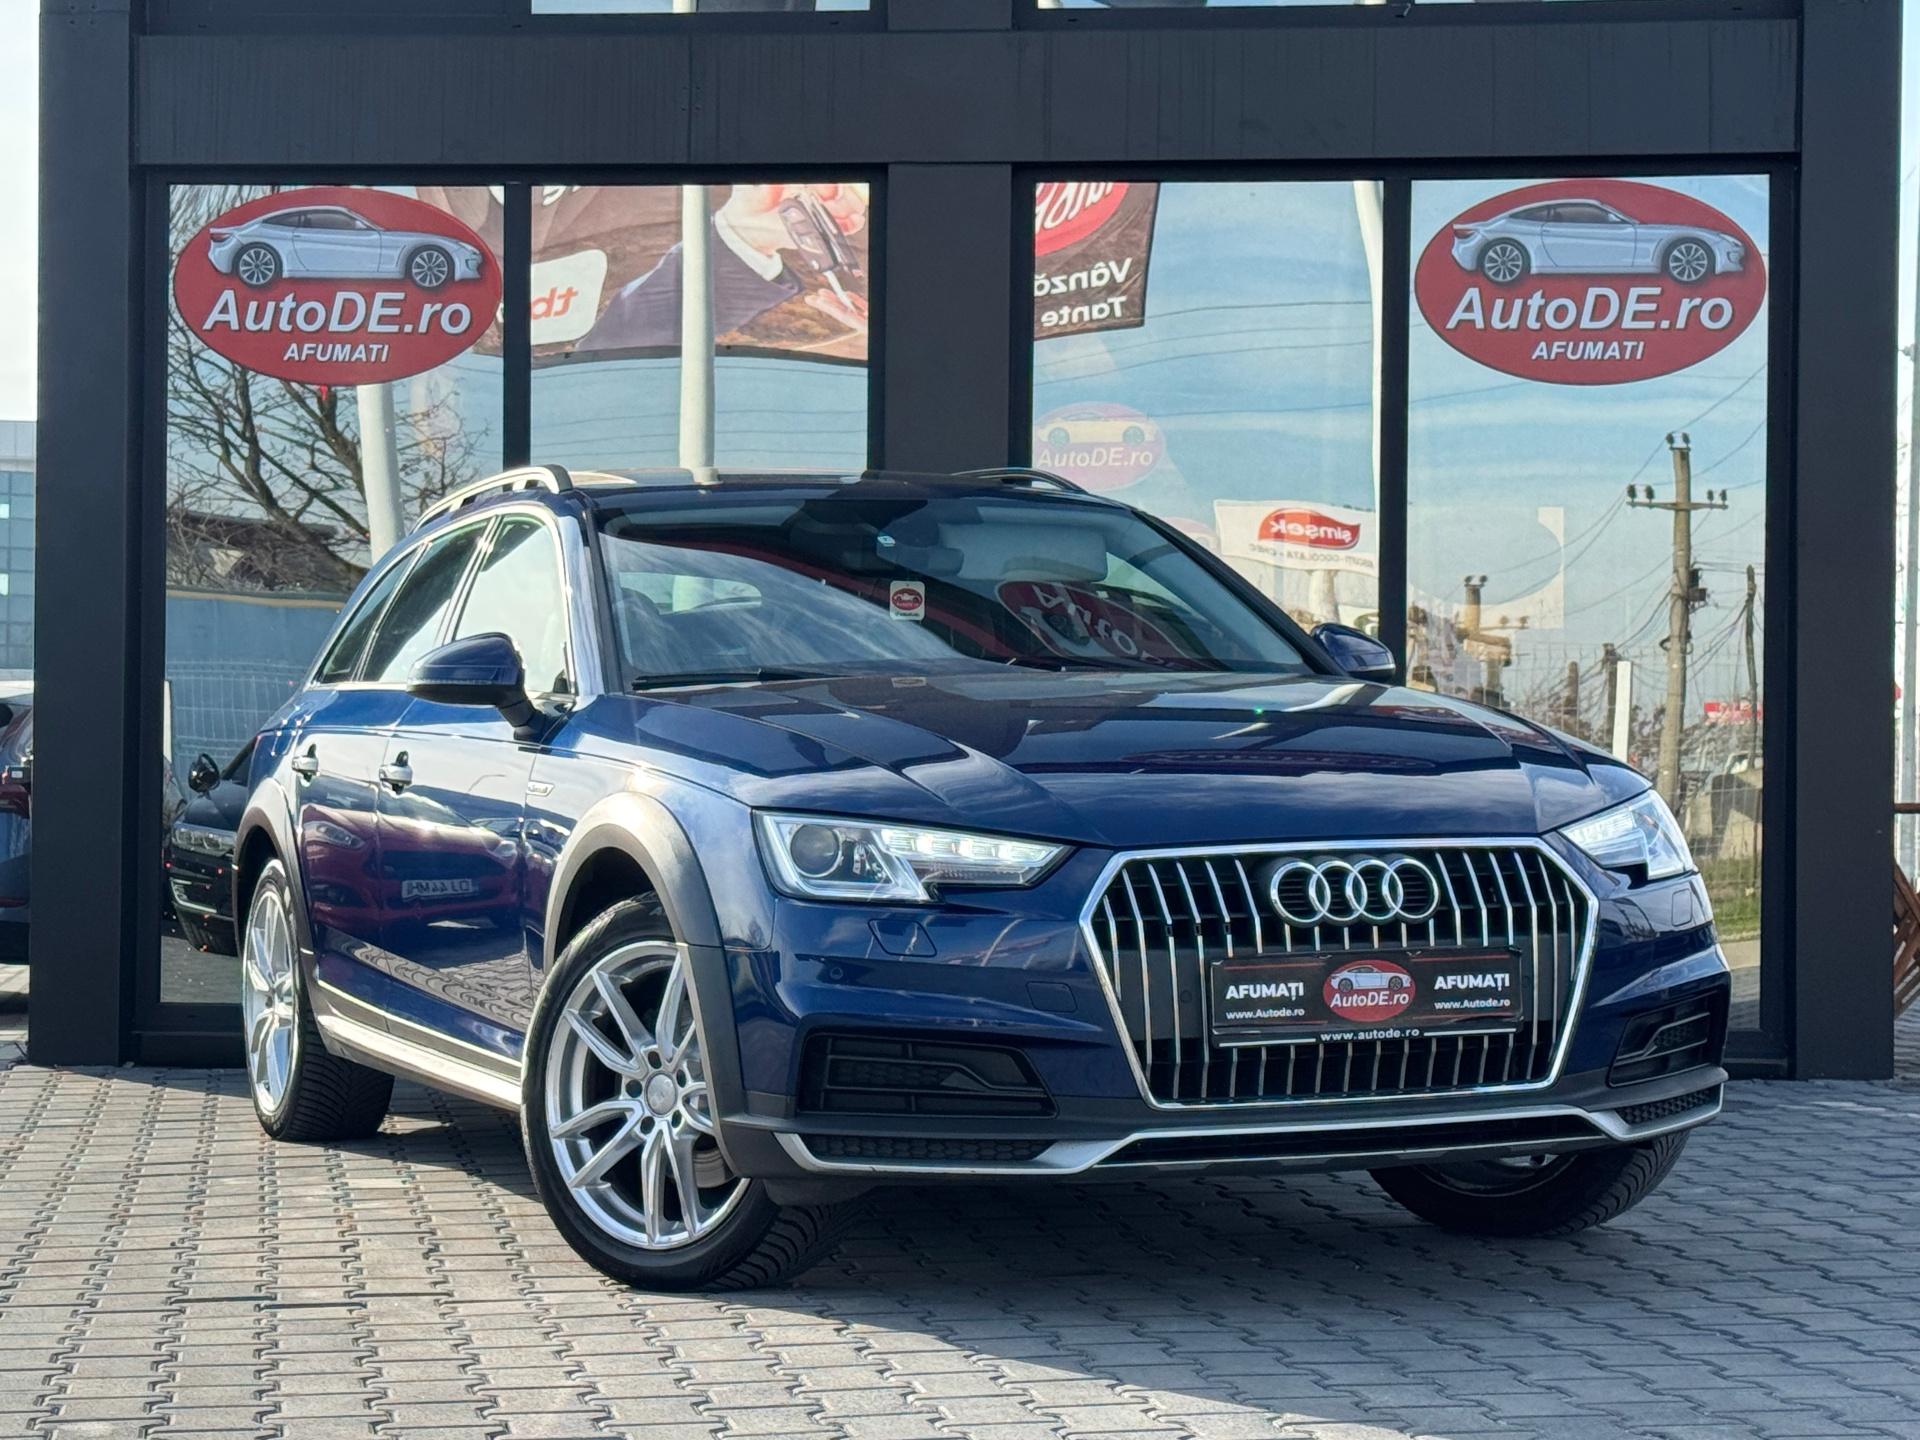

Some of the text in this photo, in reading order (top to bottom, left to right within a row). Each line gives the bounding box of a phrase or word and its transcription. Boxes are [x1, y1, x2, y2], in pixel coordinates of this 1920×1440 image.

[203, 289, 472, 334] AutoDE.ro
[1445, 286, 1733, 330] AutoDE.ro
[283, 343, 389, 362] AFUMATI
[1531, 341, 1644, 360] AFUMATI
[1038, 447, 1153, 467] AutoDE.ro
[1330, 991, 1409, 1009] AutoDE.ro
[1434, 998, 1511, 1010] www.Autode.ro
[1225, 1007, 1305, 1020] www.Autode.ro
[1320, 1027, 1419, 1042] www.autode.ro
